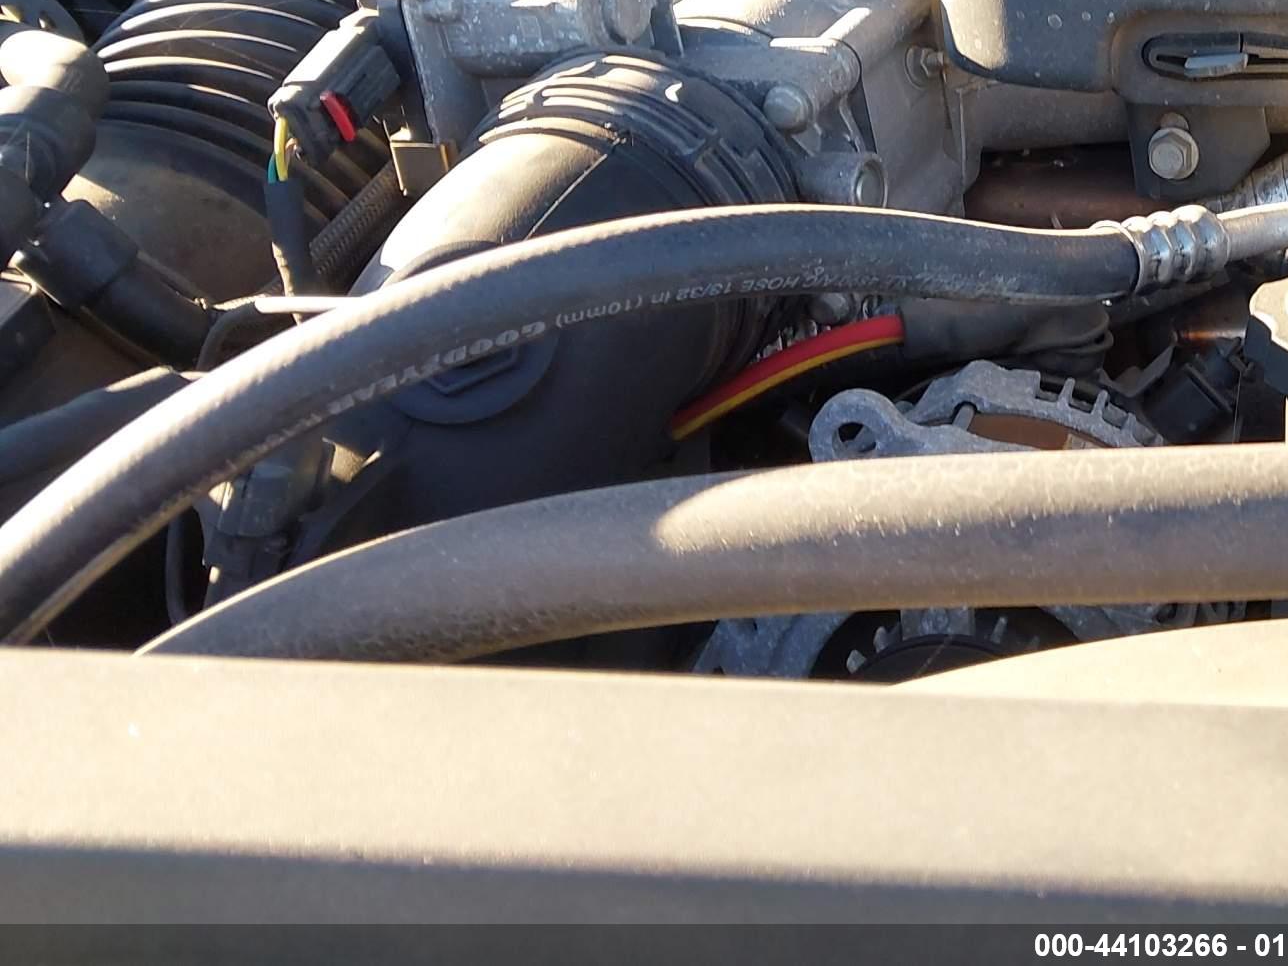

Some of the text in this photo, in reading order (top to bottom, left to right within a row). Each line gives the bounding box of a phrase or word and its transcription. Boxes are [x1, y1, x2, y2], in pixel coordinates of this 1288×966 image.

[676, 281, 732, 302] 13/32
[738, 275, 800, 293] HOSE
[555, 293, 643, 328] (10mm)
